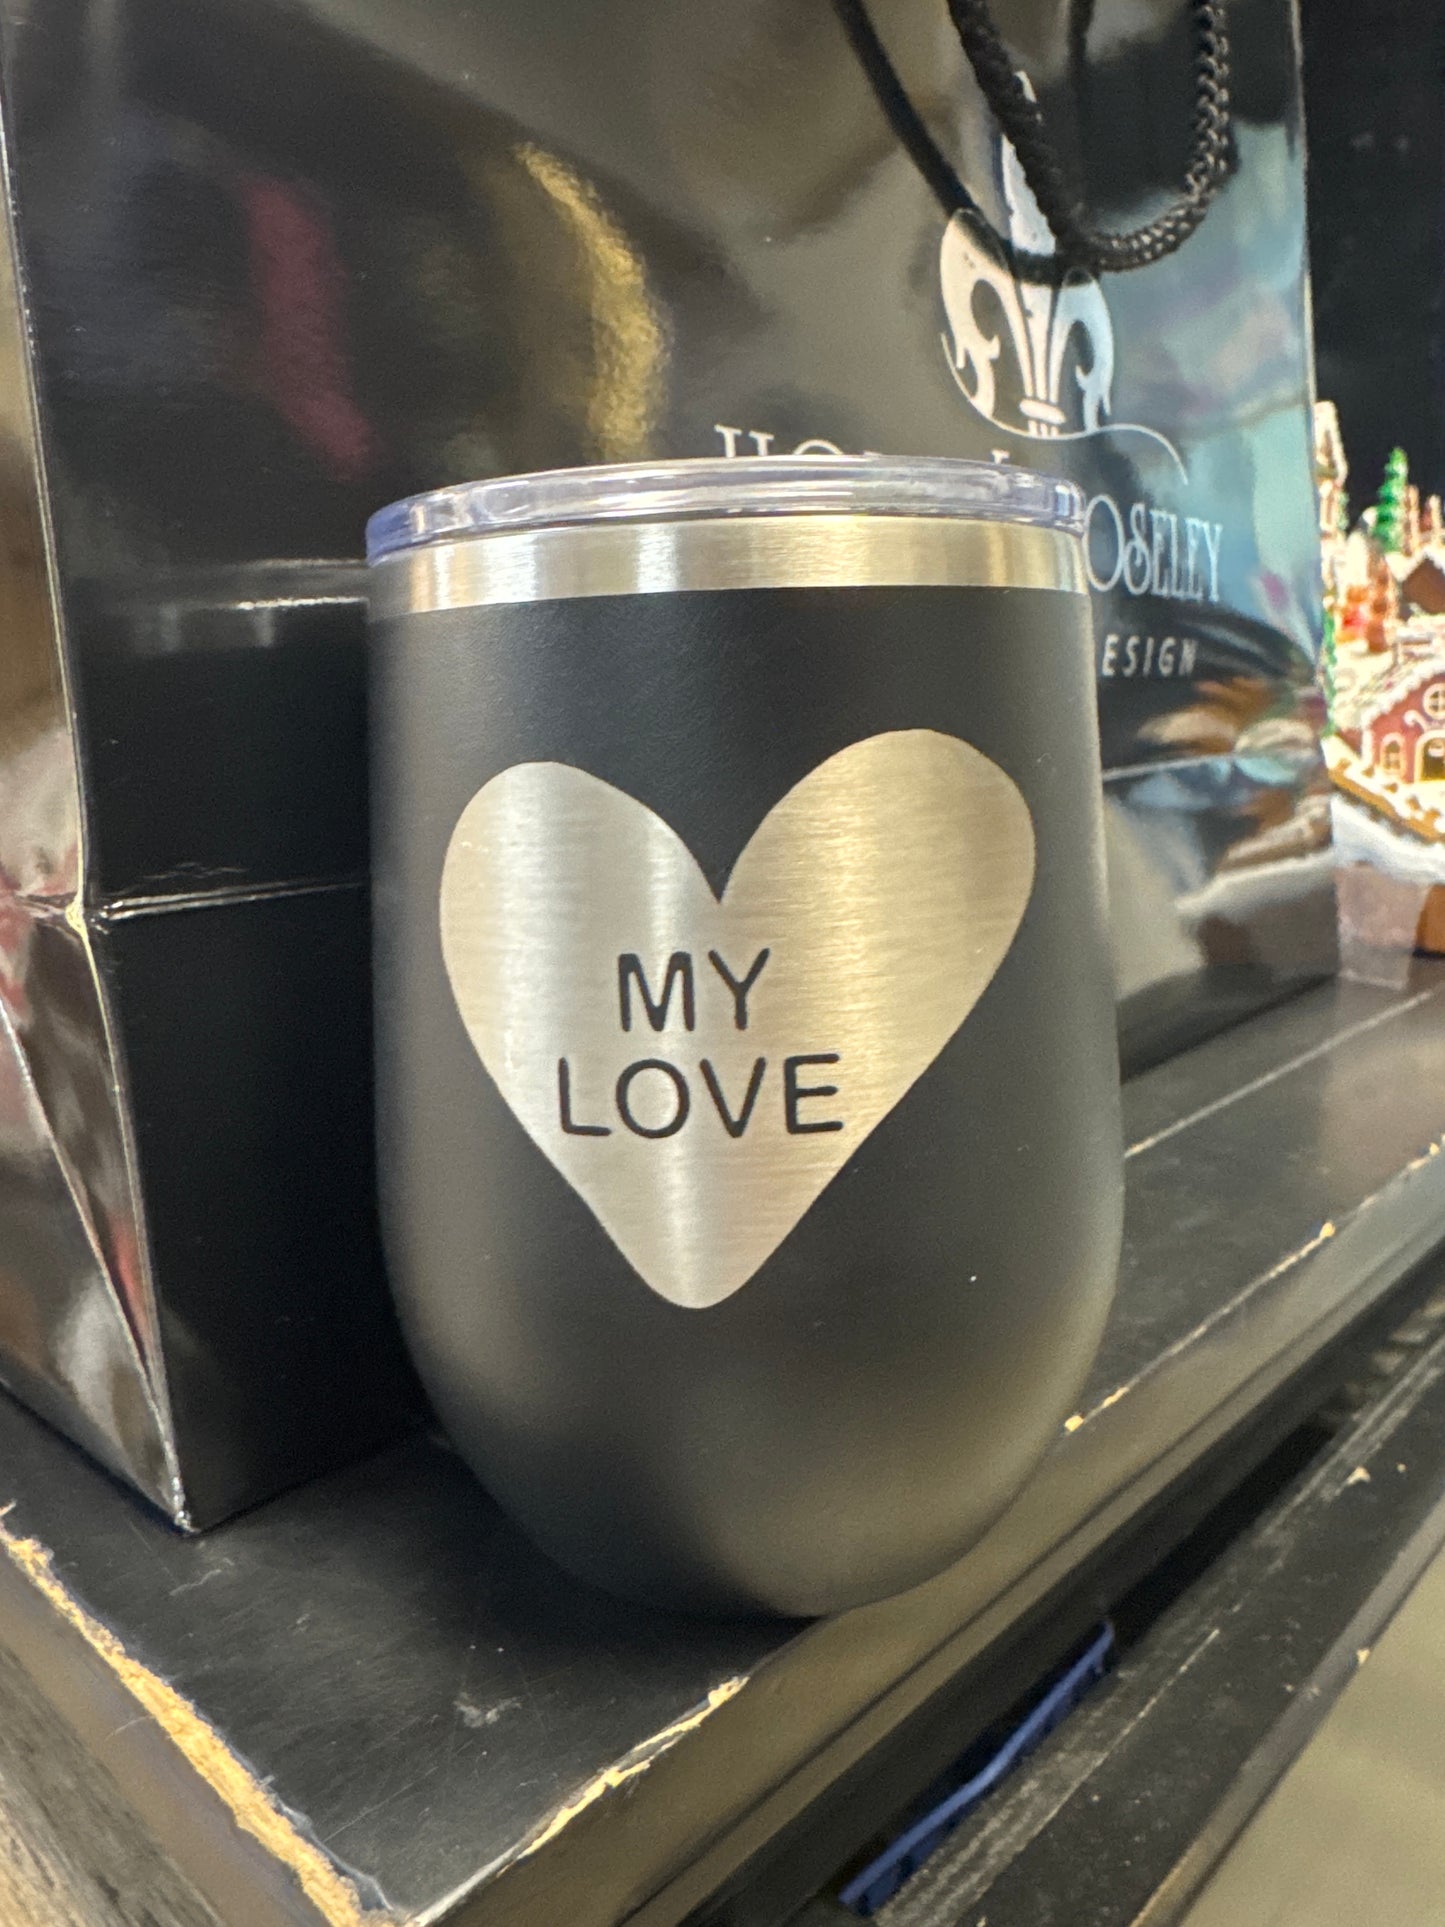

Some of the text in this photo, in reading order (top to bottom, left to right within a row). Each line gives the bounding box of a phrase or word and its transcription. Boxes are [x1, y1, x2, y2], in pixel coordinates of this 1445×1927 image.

[1082, 493, 1224, 602] OSELEY
[1101, 633, 1199, 677] ESIGN
[618, 947, 770, 1032] MY
[558, 1053, 843, 1139] LOVE
